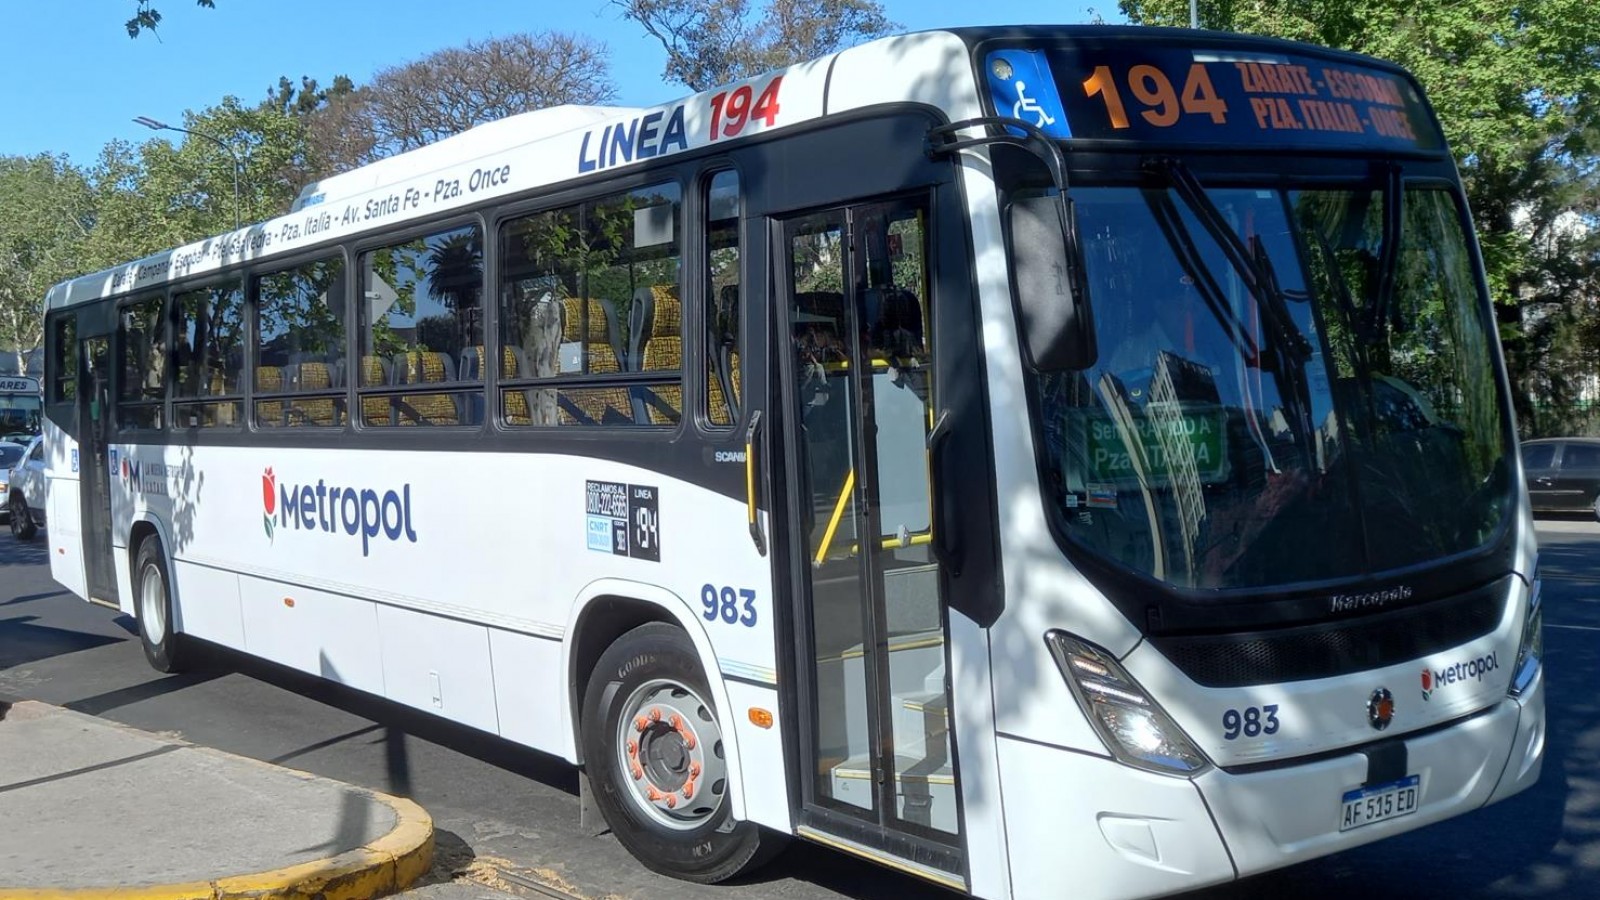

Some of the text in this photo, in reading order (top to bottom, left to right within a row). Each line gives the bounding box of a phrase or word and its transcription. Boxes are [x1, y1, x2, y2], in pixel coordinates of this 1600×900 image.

[1082, 64, 1229, 129] 194
[1235, 62, 1317, 95] ZARATE
[578, 75, 785, 173] LINEA 194
[1248, 98, 1304, 130] PZA.
[1299, 100, 1364, 133] ITALIA
[1368, 107, 1416, 140] ONCE
[230, 229, 272, 255] Saavedra
[280, 223, 301, 242] Pza.
[304, 212, 330, 237] Italia
[341, 206, 361, 226] Av.
[364, 195, 399, 220] Santa
[403, 187, 419, 211] Fe
[434, 180, 463, 201] Pza.
[469, 164, 510, 191] Once
[1092, 420, 1130, 440] Sem
[1200, 415, 1211, 434] A
[587, 482, 617, 494] RECLAMOS
[634, 489, 653, 500] LINEA
[280, 478, 417, 557] Metropol
[589, 521, 608, 533] CNRT
[636, 507, 658, 549] 194
[701, 583, 757, 628] 983
[1434, 650, 1499, 688] Metropol
[1222, 704, 1280, 740] 983
[1344, 801, 1362, 826] AF
[1366, 794, 1393, 820] 515
[1397, 788, 1415, 811] ED
